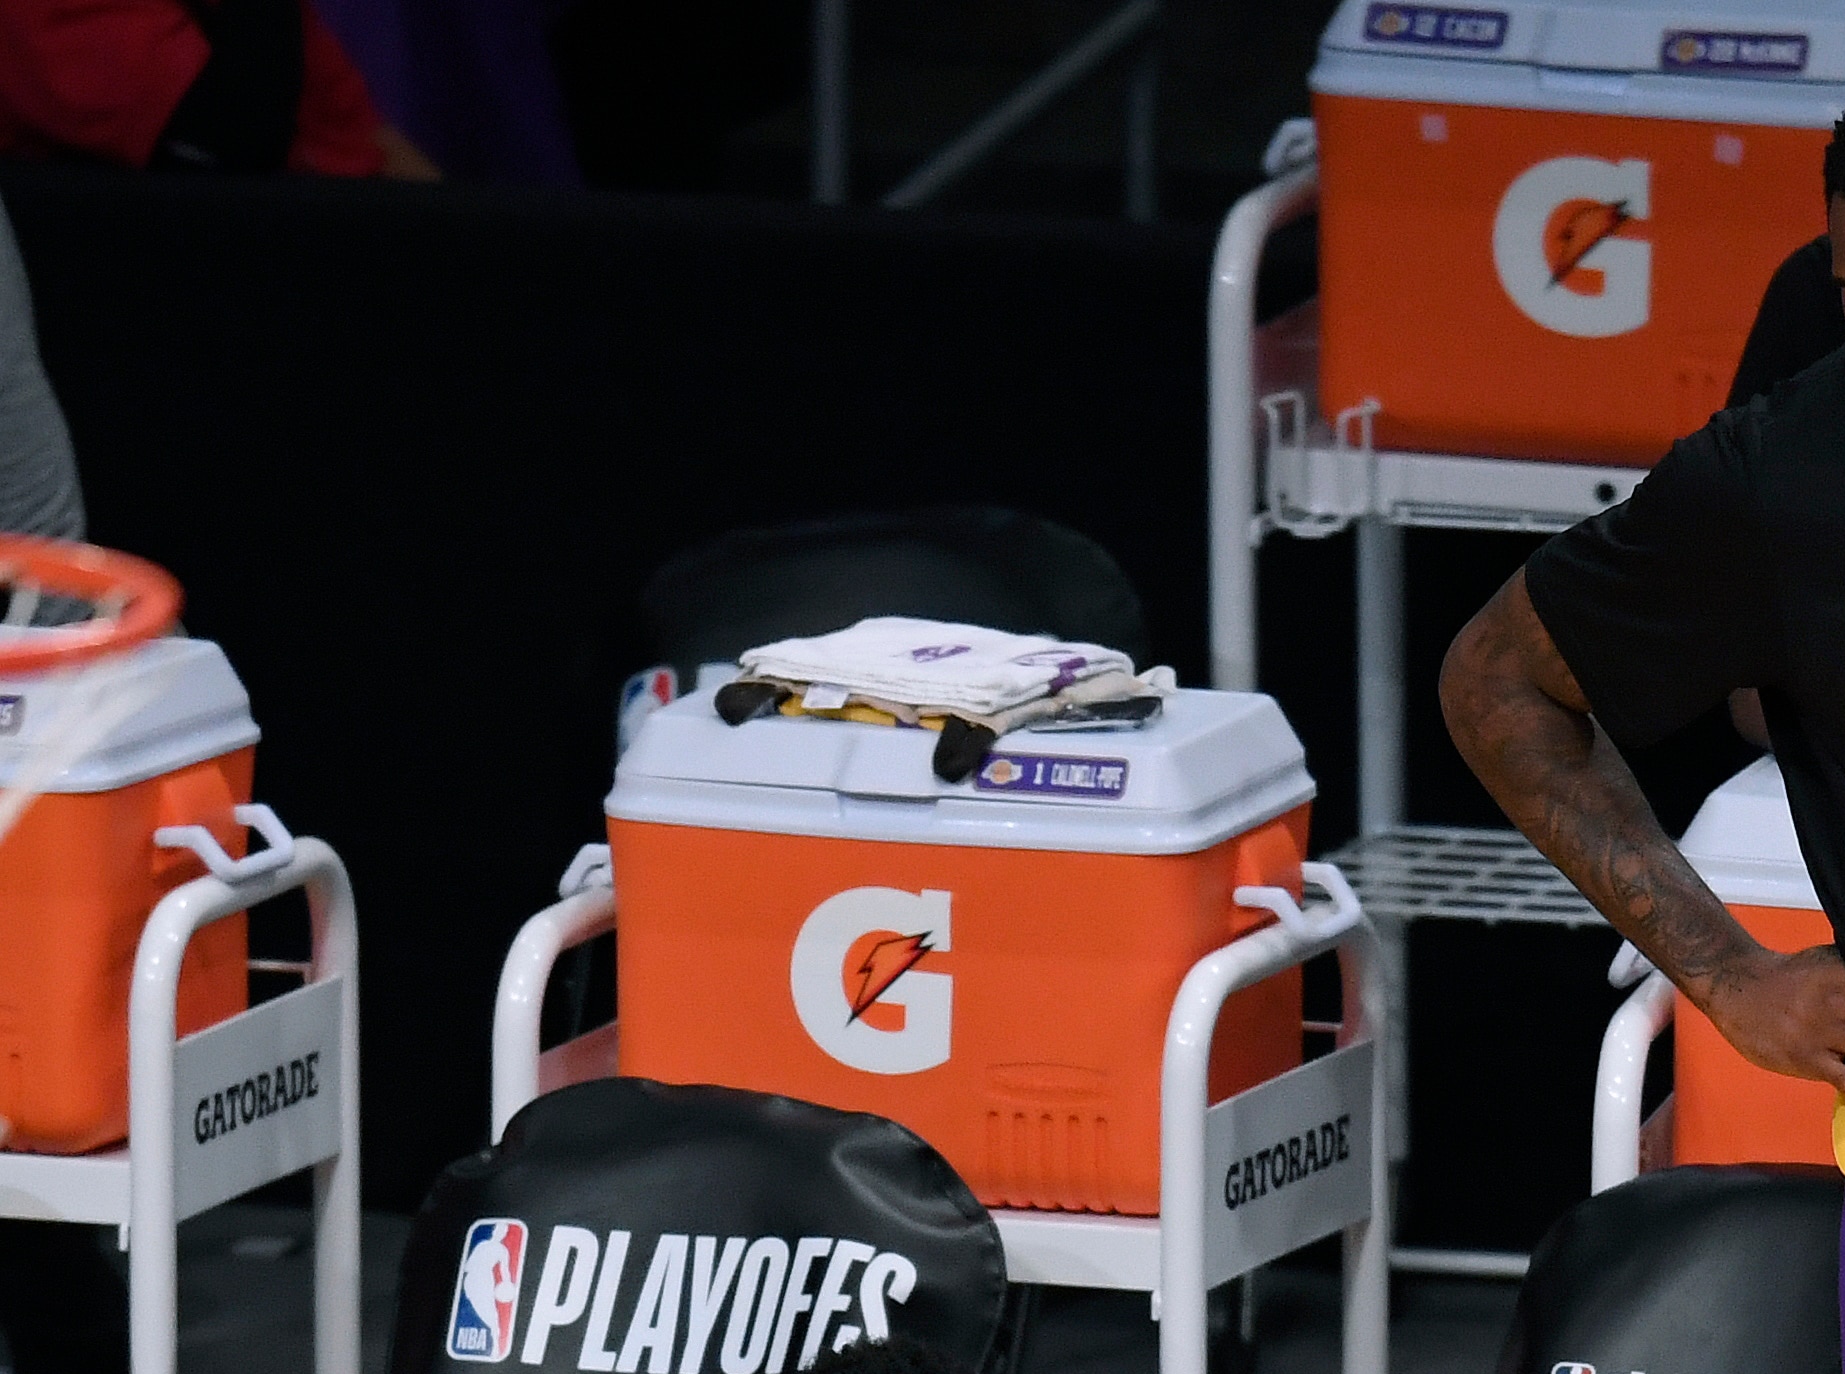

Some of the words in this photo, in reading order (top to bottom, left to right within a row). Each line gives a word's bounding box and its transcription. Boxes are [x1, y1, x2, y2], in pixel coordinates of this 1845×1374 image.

[1493, 156, 1652, 338] G
[790, 885, 954, 1075] G
[194, 1051, 319, 1145] GATORADE
[1224, 1113, 1350, 1211] GATORADE
[456, 1327, 487, 1350] NBA
